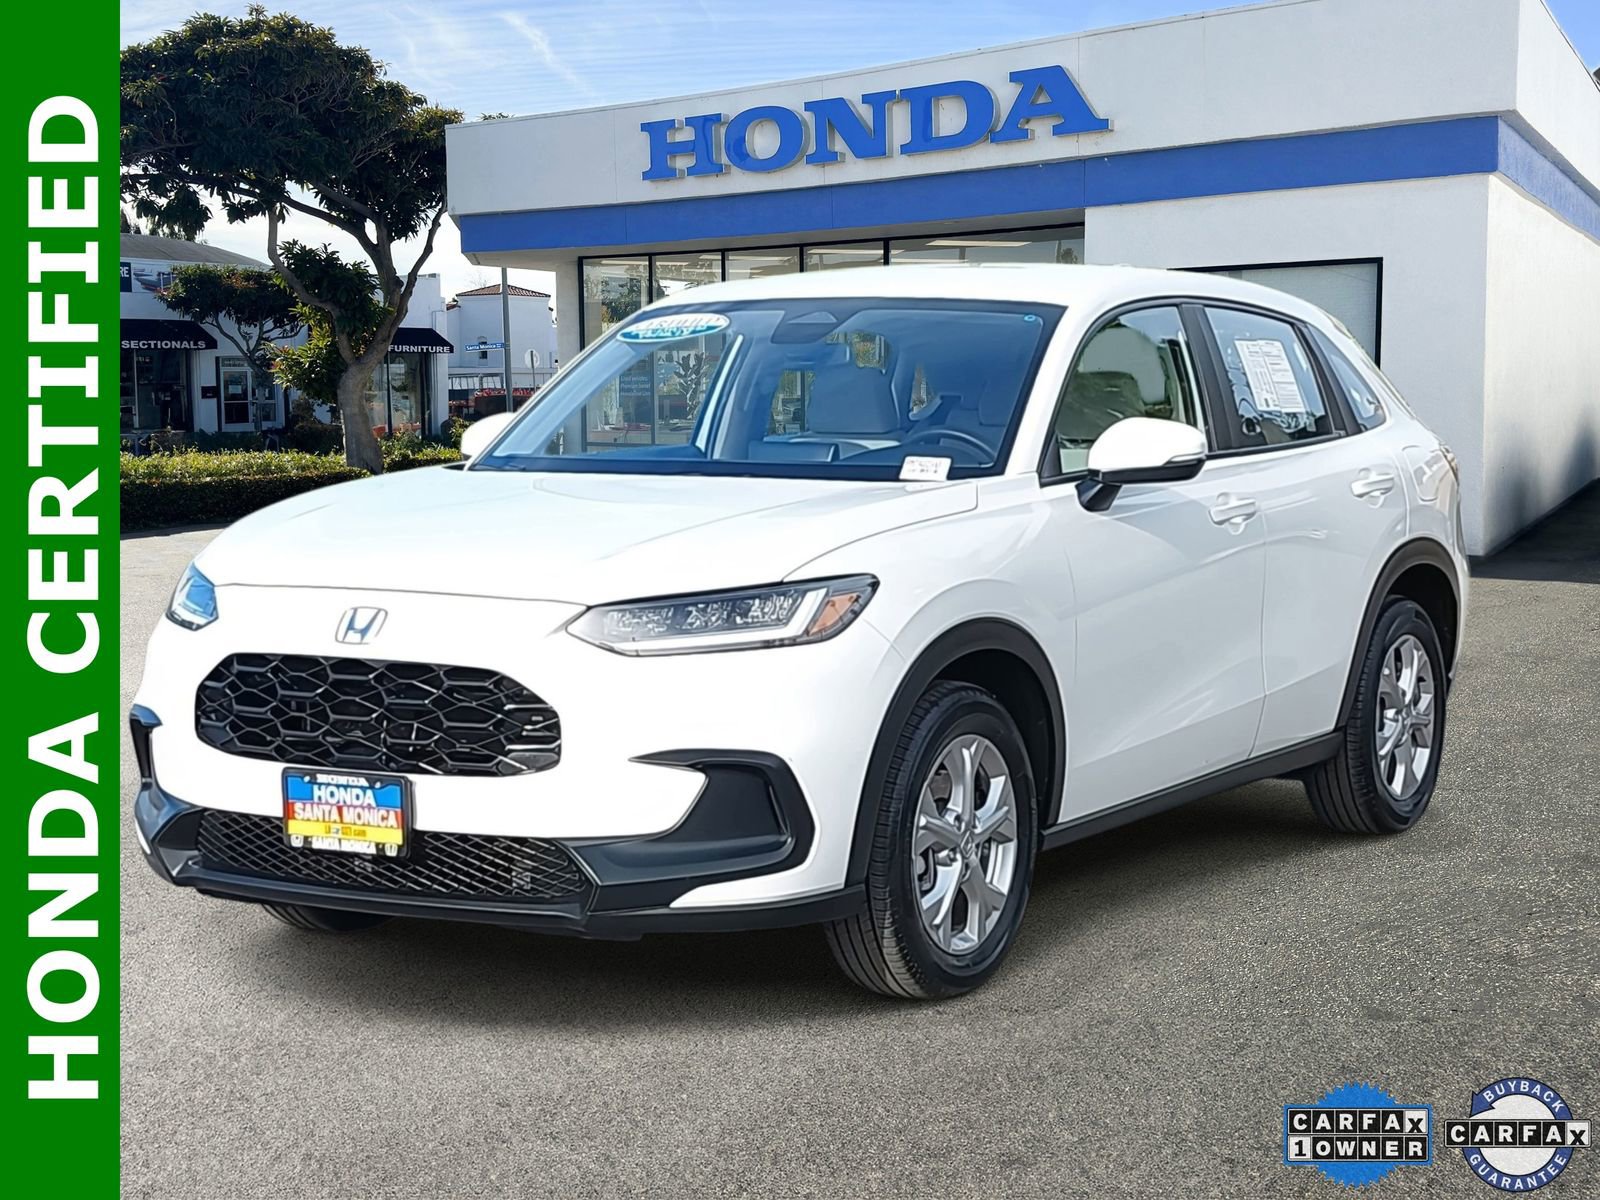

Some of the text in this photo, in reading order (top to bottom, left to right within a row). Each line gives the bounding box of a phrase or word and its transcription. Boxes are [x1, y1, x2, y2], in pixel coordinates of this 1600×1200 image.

[640, 65, 1111, 182] HONDA
[121, 340, 206, 349] SECTIONALS
[389, 344, 451, 353] FURNITURE
[313, 785, 376, 807] HONDA
[294, 804, 398, 828] SANTA MONICA
